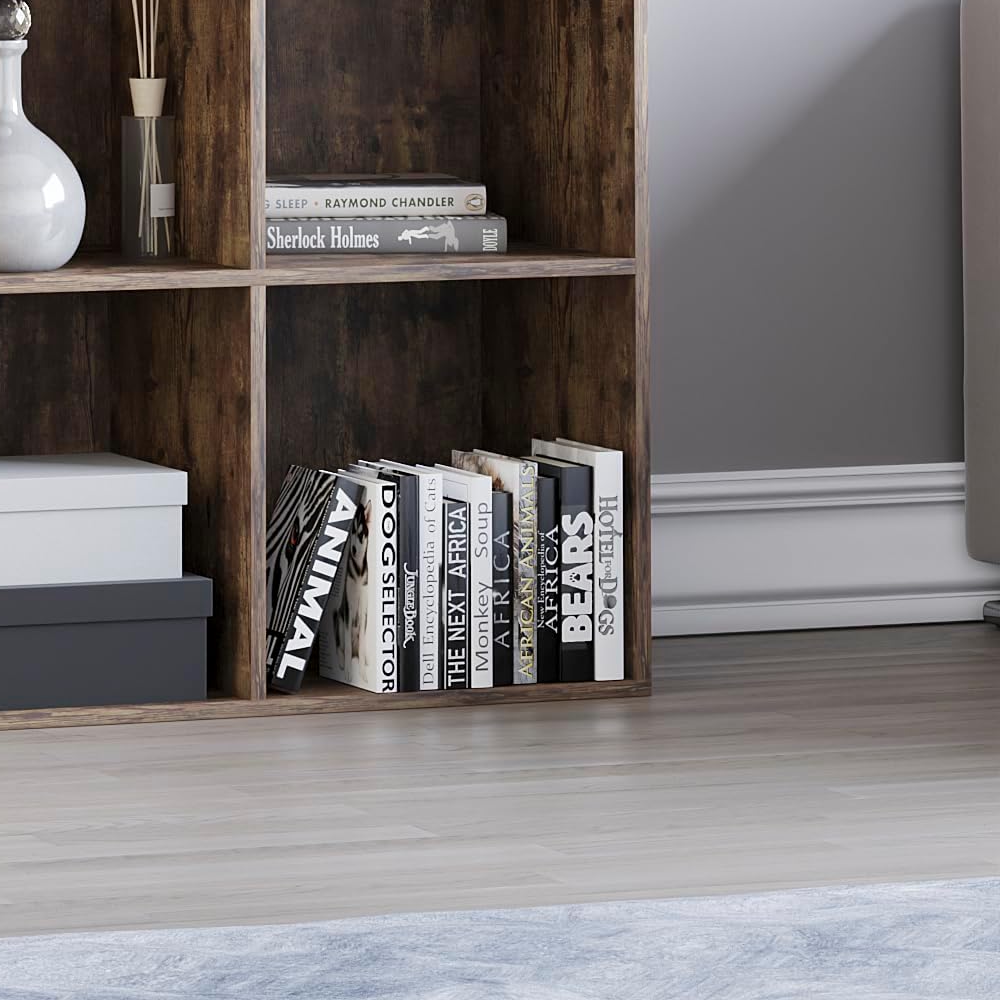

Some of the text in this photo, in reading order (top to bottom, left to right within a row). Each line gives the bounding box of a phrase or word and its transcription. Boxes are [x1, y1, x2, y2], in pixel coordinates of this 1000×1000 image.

[267, 226, 380, 249] Sherlock Holmes
[275, 199, 308, 209] SLEEP
[325, 198, 387, 209] RAYMOND
[392, 197, 455, 208] CHANDLER
[482, 228, 498, 252] DOYLE
[276, 487, 358, 680] ANIMAL
[423, 477, 437, 685] Dell Encyclopedia of Cats
[473, 502, 492, 671] Monkey Soup
[518, 465, 536, 678] AFRICAN ANIMALS
[537, 544, 546, 604] Encyclopedia
[544, 524, 559, 634] AFRICA
[562, 511, 594, 643] BEARS
[598, 496, 620, 563] HOTEL
[448, 506, 467, 687] THE NEXT AFRICA
[493, 530, 511, 648] AFRICA
[537, 607, 545, 629] New
